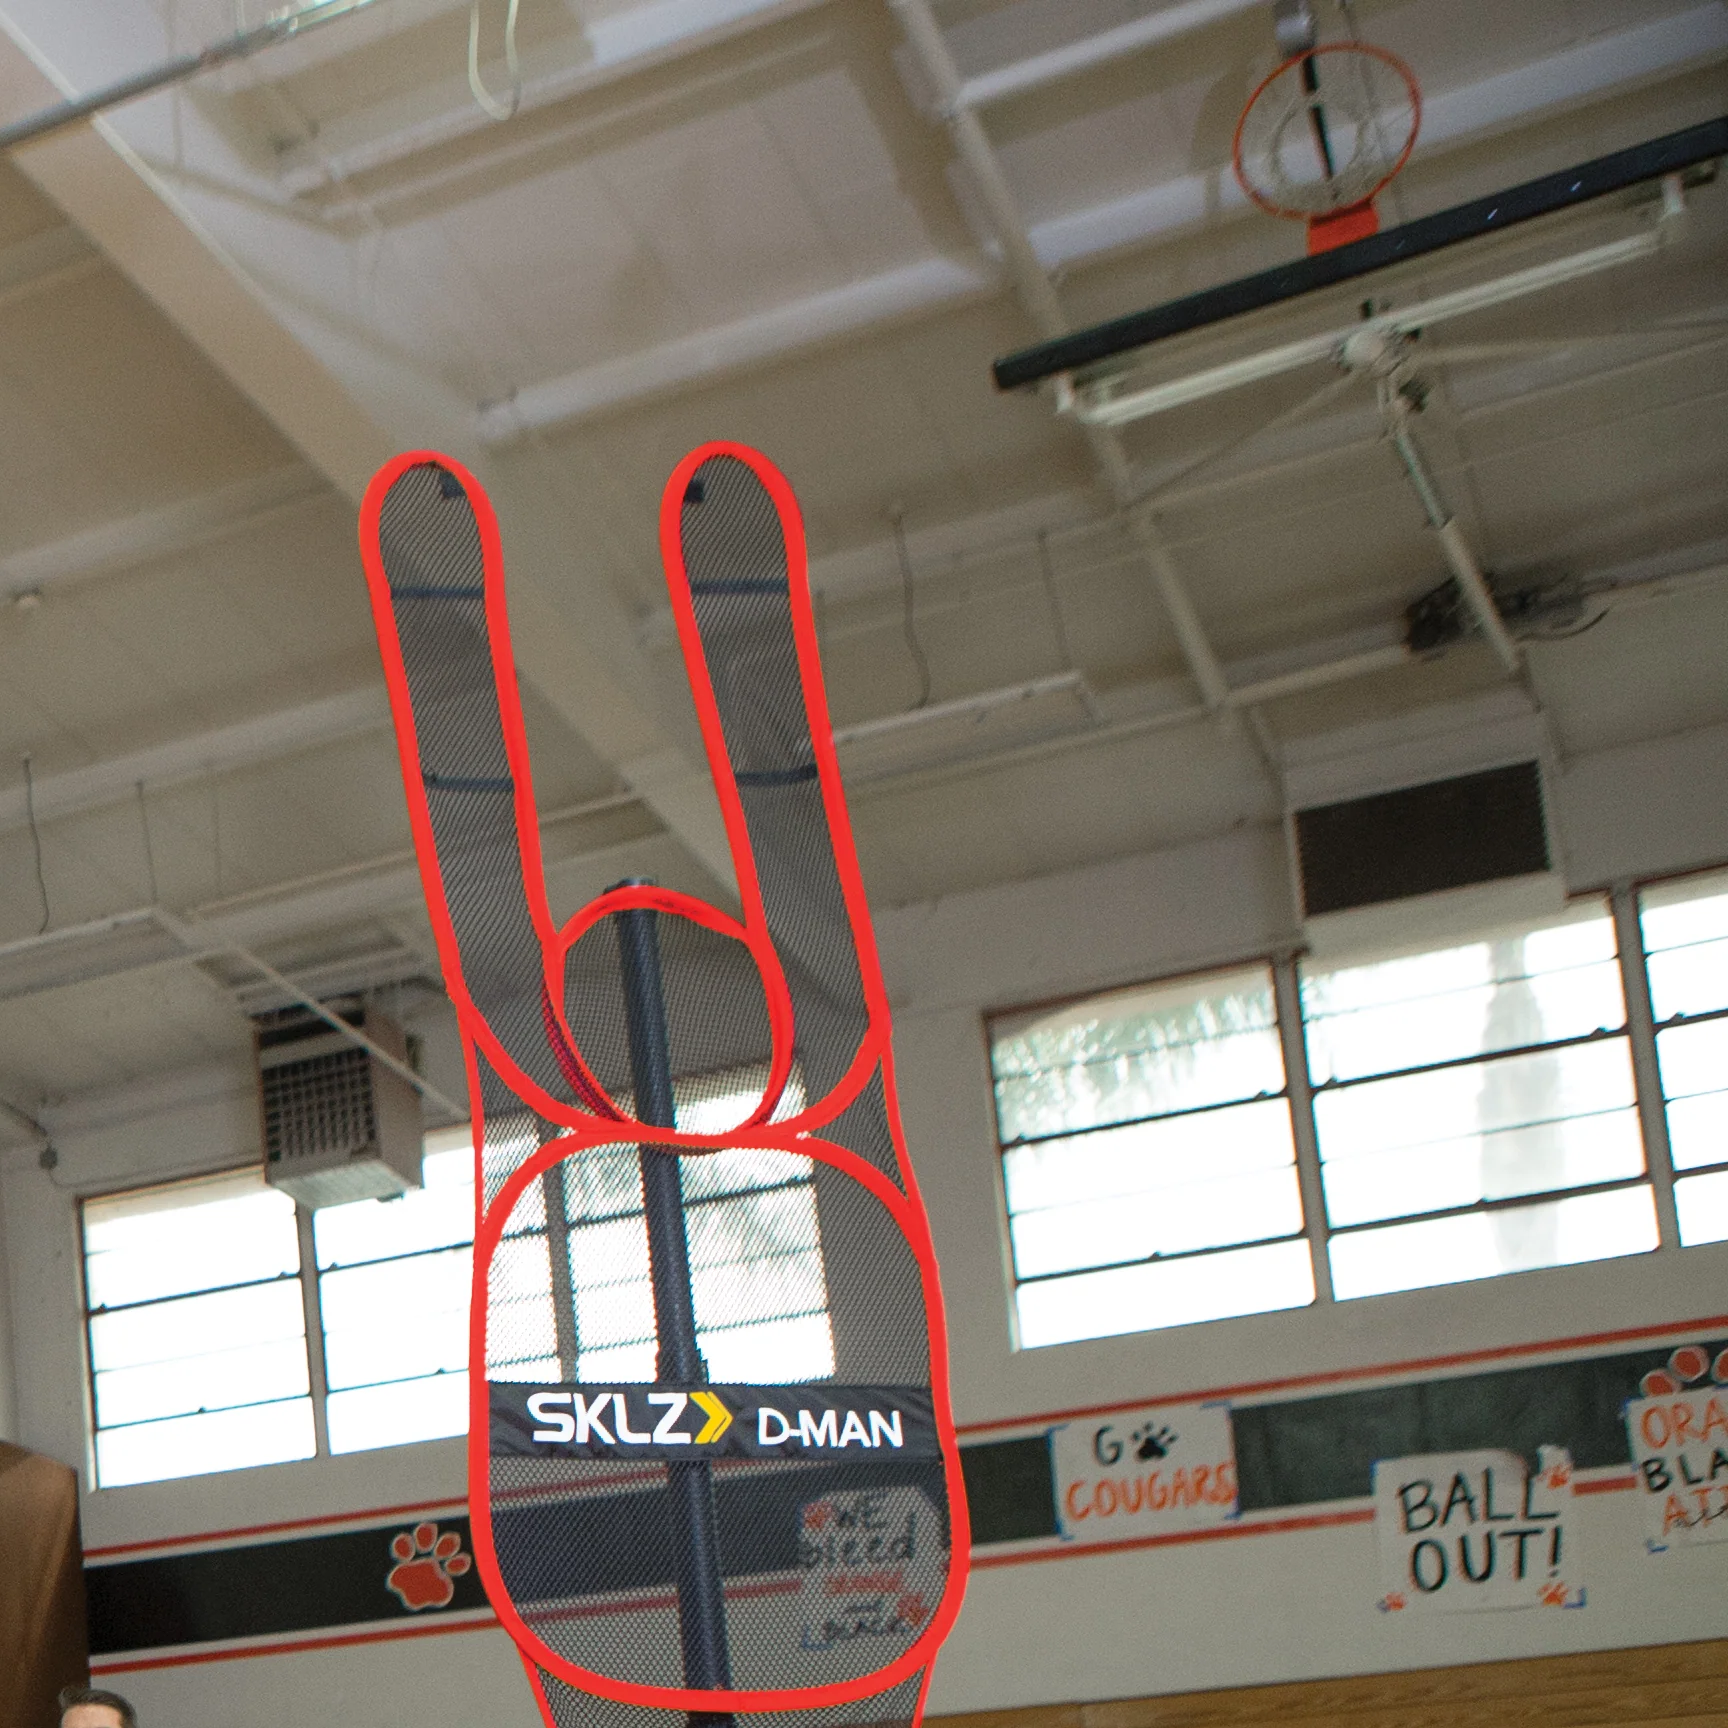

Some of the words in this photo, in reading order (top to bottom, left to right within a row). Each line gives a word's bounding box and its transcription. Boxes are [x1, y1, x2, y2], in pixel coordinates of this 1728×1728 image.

[525, 1391, 691, 1445] SKLZ
[757, 1407, 904, 1448] D-MAN
[1065, 1460, 1238, 1522] COUGARS
[1397, 1466, 1561, 1535] BALL
[1409, 1524, 1562, 1593] OUT!
